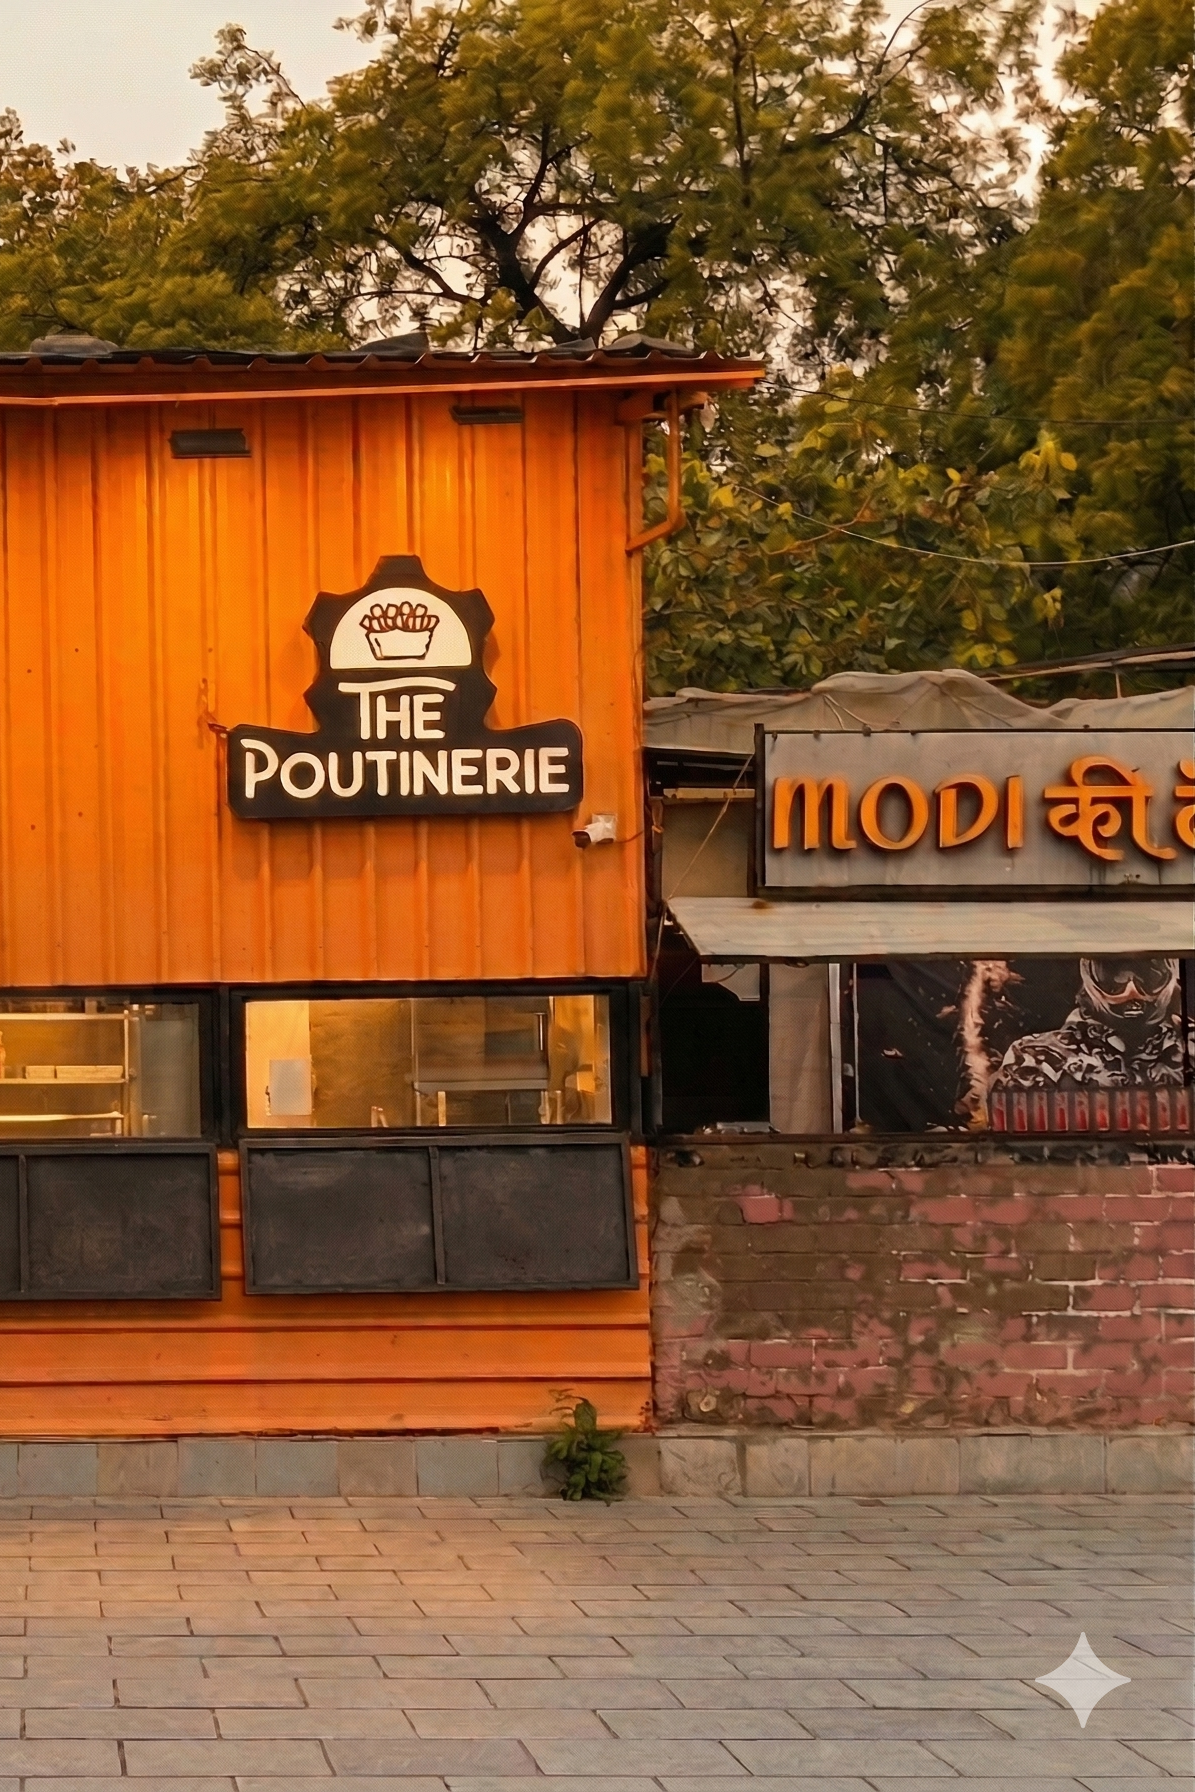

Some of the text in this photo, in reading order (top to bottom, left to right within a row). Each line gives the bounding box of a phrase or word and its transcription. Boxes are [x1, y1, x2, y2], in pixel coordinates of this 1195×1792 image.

[338, 677, 456, 739] THE
[240, 739, 569, 798] POUTINERIE
[772, 774, 1024, 850] MODI
[1043, 755, 1178, 861] की
